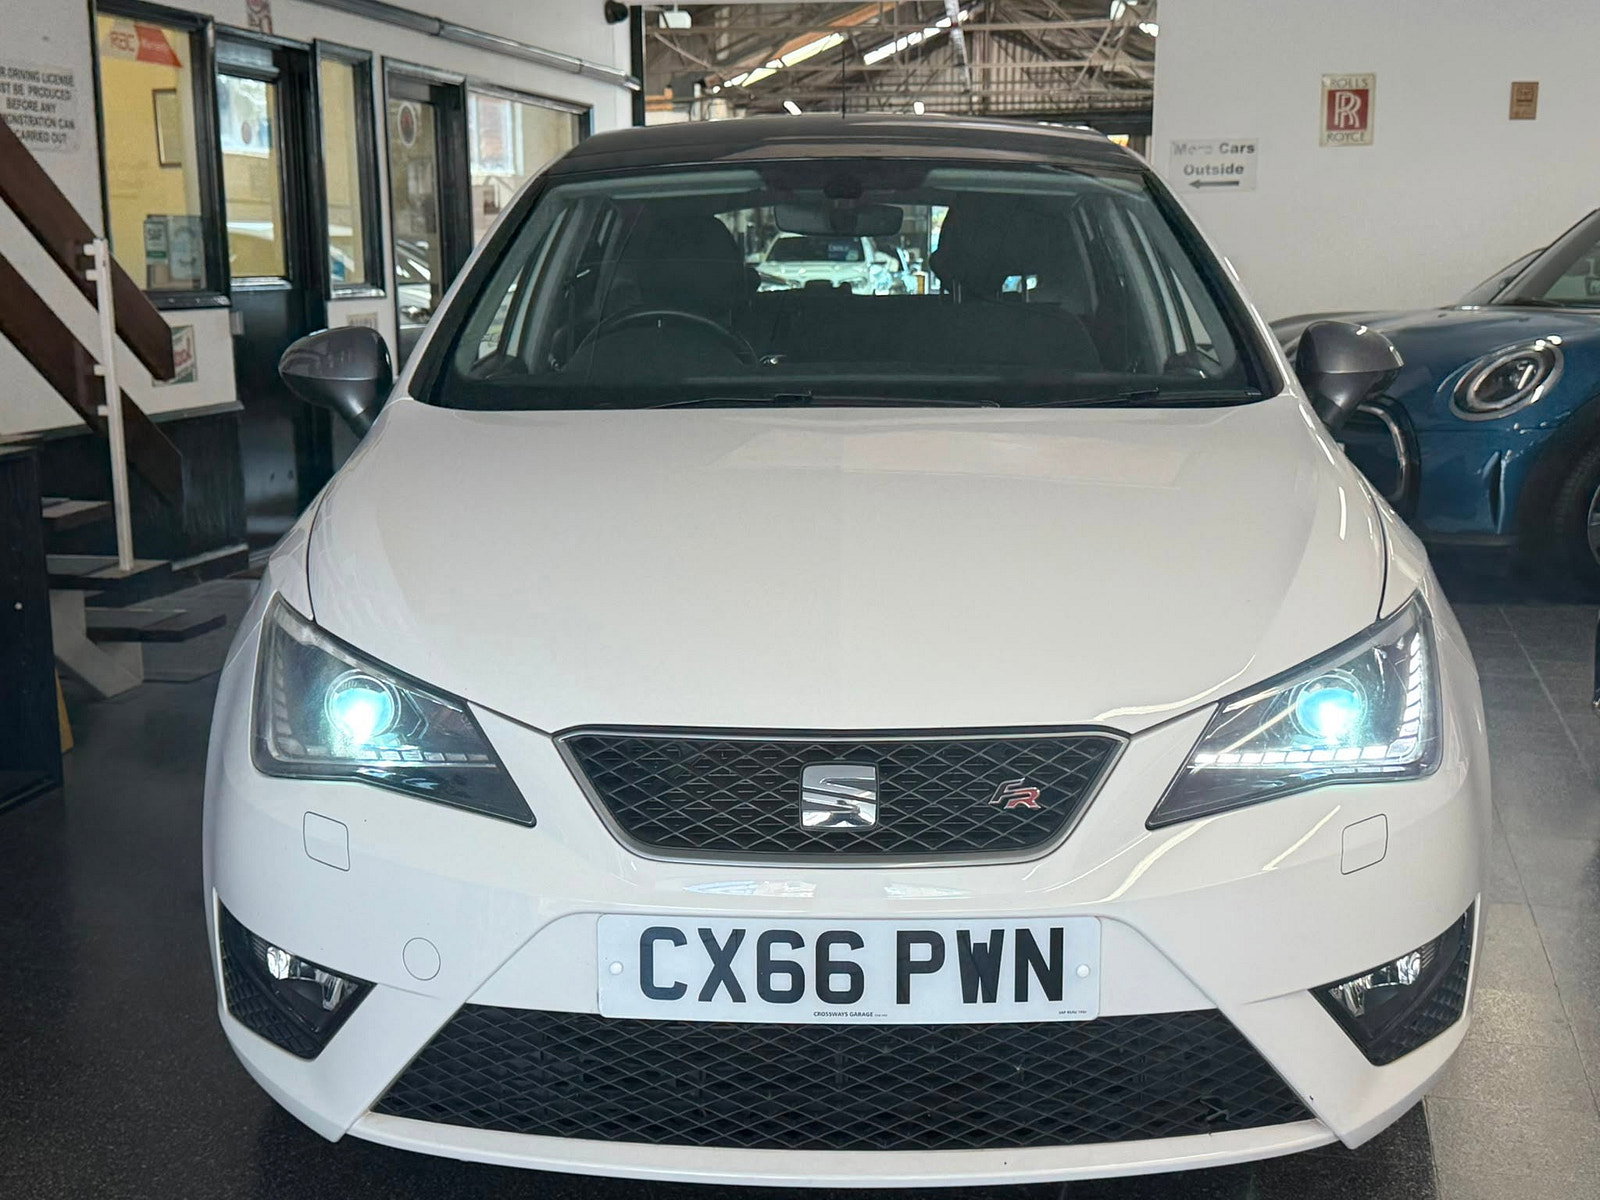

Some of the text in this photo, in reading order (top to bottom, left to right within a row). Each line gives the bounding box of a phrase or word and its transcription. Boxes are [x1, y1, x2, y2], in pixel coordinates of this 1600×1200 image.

[1331, 77, 1368, 88] ROLLS
[1327, 132, 1365, 142] ROYCE
[1219, 142, 1255, 155] Cars
[1184, 163, 1244, 176] Outside
[639, 926, 1064, 1004] CX66 PWN
